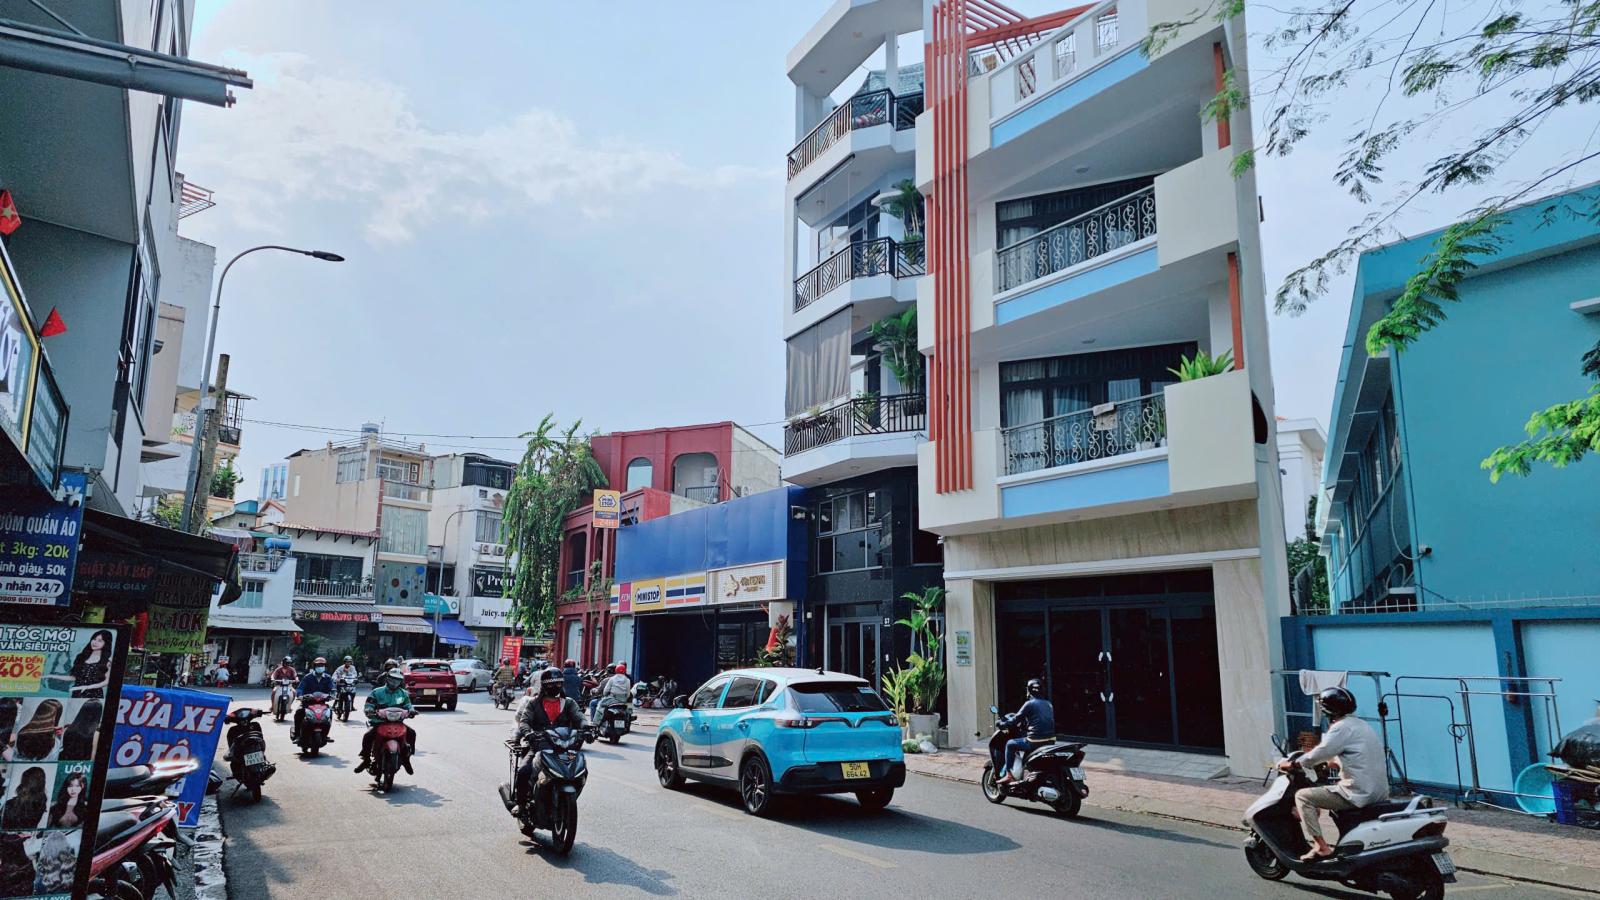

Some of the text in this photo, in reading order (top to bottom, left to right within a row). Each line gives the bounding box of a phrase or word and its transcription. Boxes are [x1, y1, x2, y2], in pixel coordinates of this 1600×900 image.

[60, 516, 77, 537] ÁO
[11, 541, 39, 558] 3kg:
[44, 544, 70, 558] 20k
[46, 564, 66, 576] 50k
[6, 580, 32, 593] nhận
[35, 582, 61, 593] 24/7
[44, 627, 76, 642] MỚI
[25, 641, 48, 652] SIÊU
[0, 662, 41, 678] 40%
[117, 692, 220, 733] RỬA XE
[115, 734, 142, 767] Ô
[64, 763, 91, 774] UỐN
